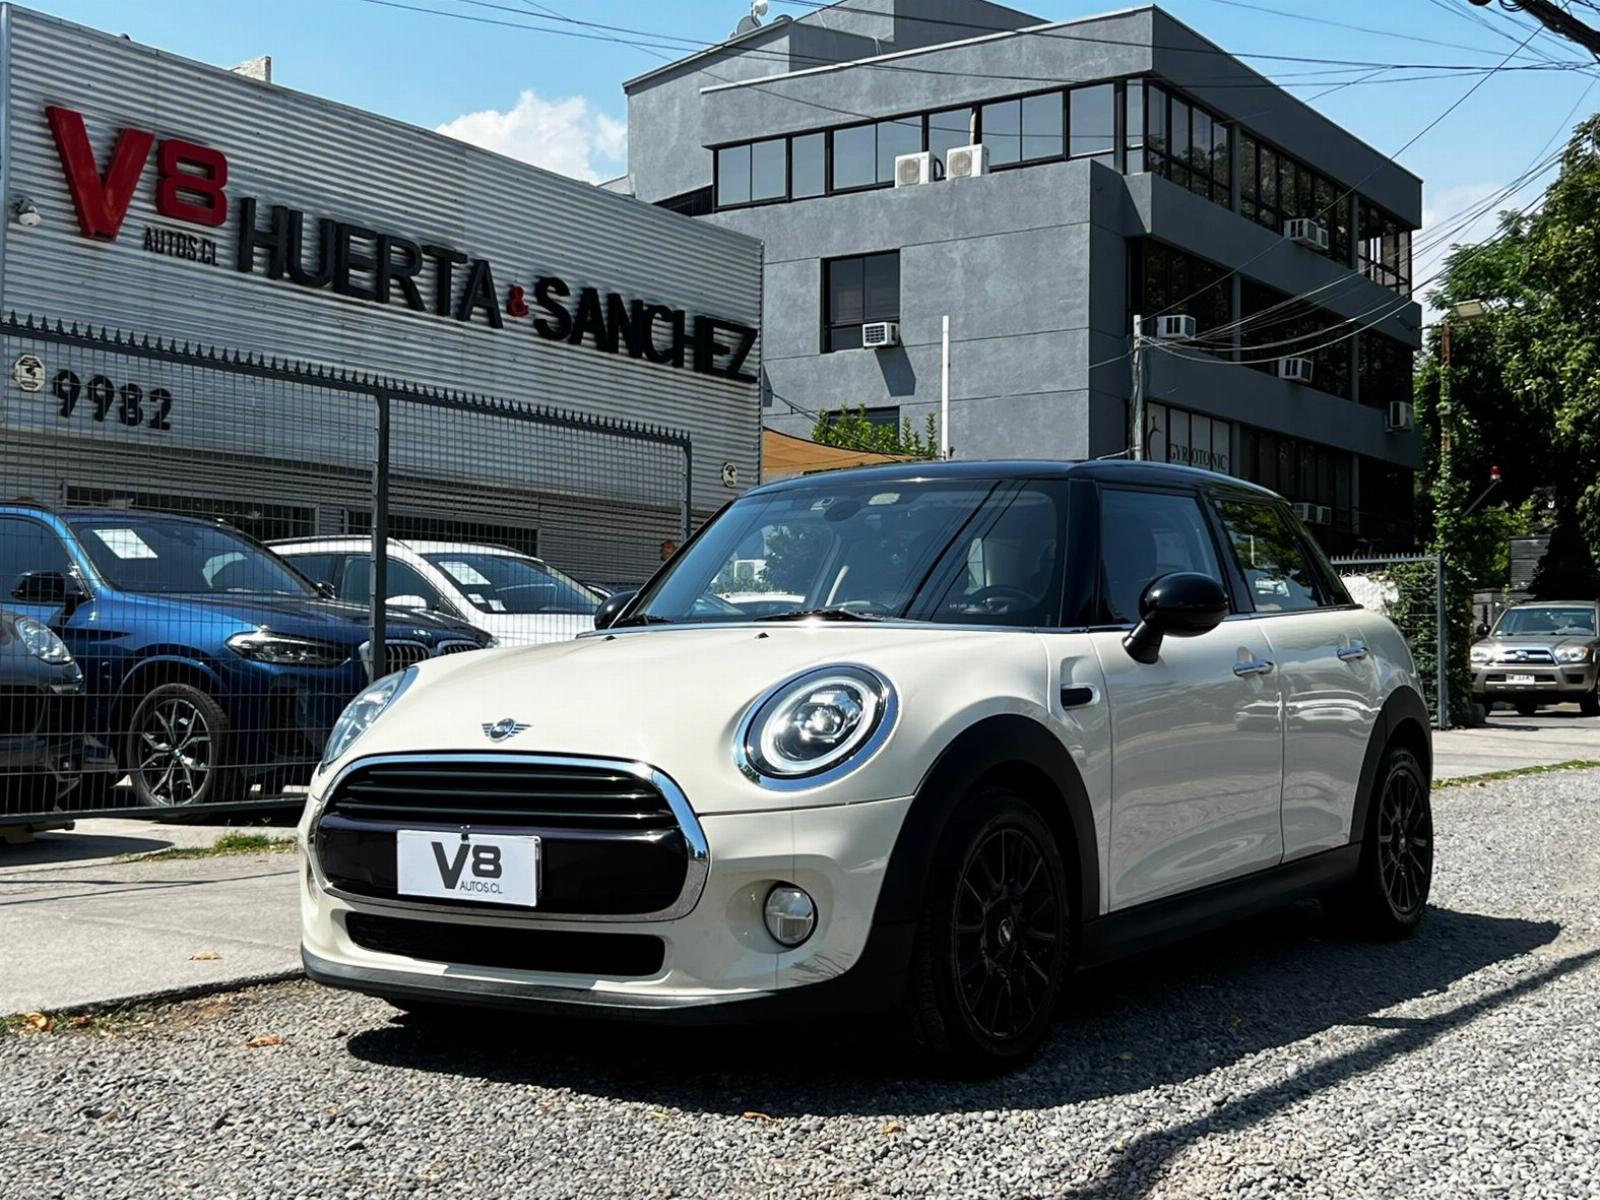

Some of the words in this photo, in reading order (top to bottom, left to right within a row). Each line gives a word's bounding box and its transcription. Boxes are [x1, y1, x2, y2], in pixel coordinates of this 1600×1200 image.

[45, 105, 228, 243] V8
[142, 225, 219, 267] AUTOS.CL
[236, 196, 503, 329] HUERTA
[506, 285, 529, 317] &
[533, 275, 759, 384] SANCHEZ
[52, 369, 173, 430] 9982
[431, 841, 503, 890] V8
[460, 881, 503, 894] AUTOS.CL
